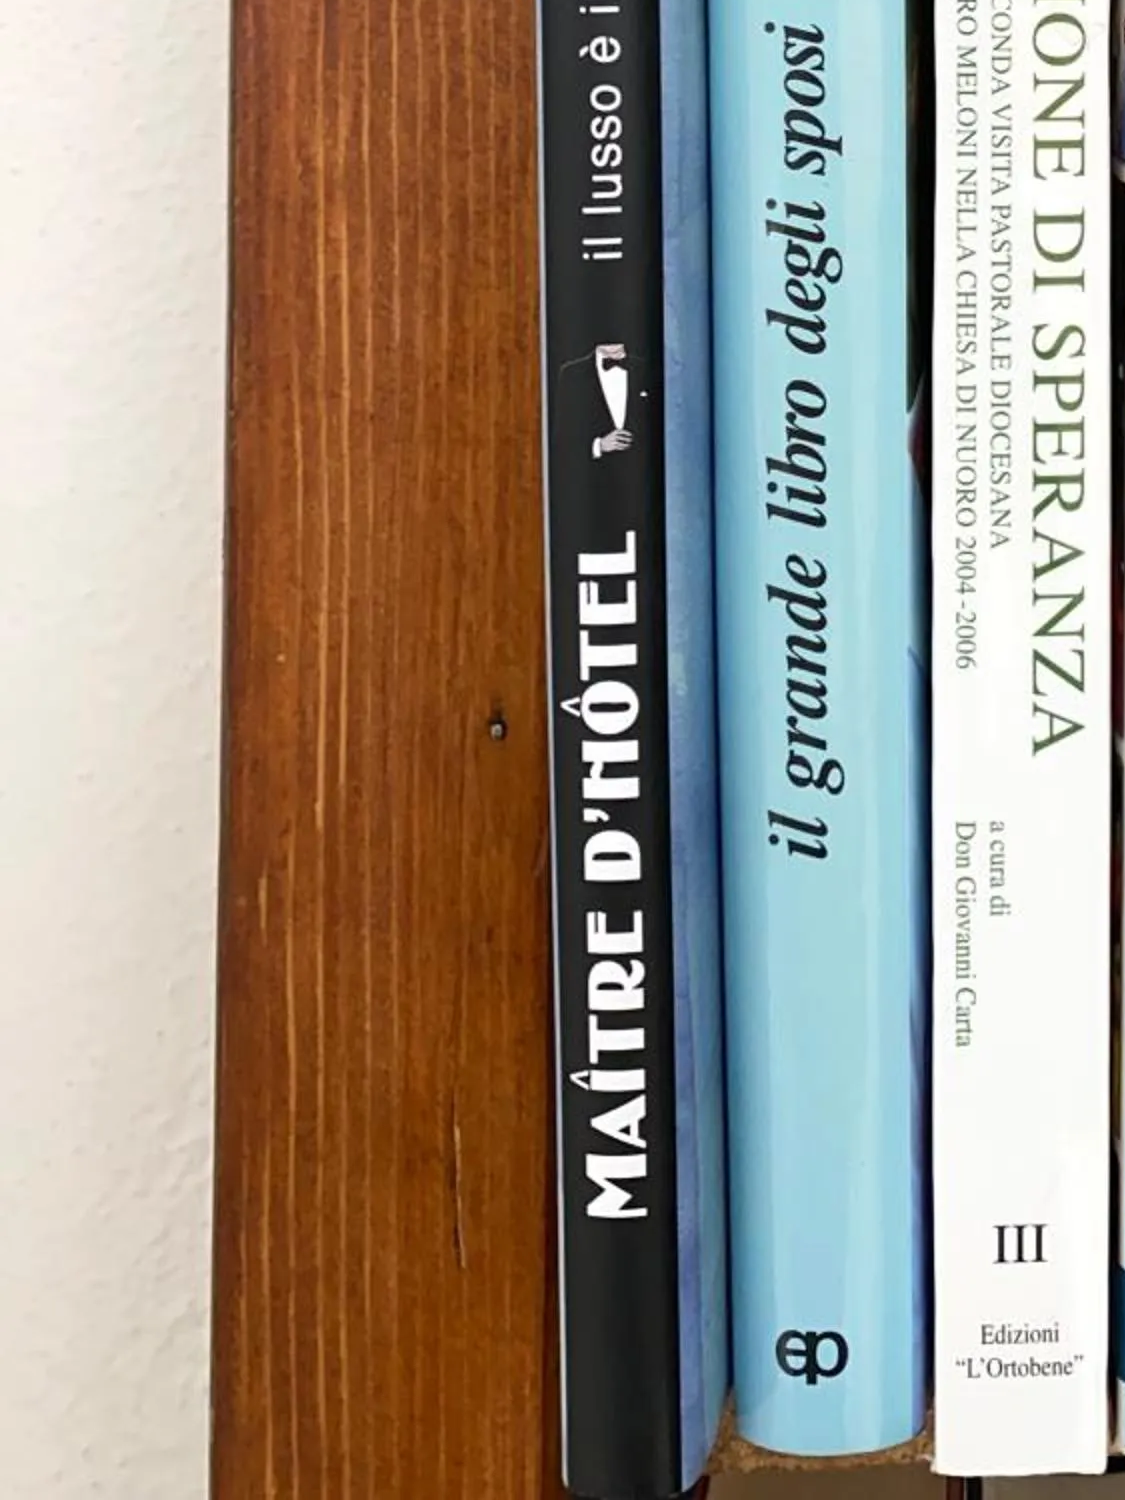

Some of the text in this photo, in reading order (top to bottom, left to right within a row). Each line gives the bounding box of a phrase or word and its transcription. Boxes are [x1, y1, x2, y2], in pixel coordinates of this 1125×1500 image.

[579, 36, 622, 63] è
[954, 45, 978, 158] MELONI
[583, 84, 623, 217] lusso
[989, 103, 1012, 195] VISITA
[582, 235, 623, 261] il
[954, 168, 978, 262] NELLA
[1031, 207, 1086, 292] DI
[954, 270, 978, 374] CHIESA
[989, 204, 1012, 370] PASTORALE
[764, 20, 845, 859] il grande libro degli sposi
[954, 384, 978, 415] DI
[954, 423, 978, 527] NUORO
[989, 380, 1012, 549] DIOCESANA
[1031, 322, 1087, 758] SPERANZA
[561, 531, 648, 1219] MAÎTRE D'HÔTEL
[988, 821, 1011, 917] a cura di
[953, 821, 977, 1047] Don Giovanni Carta
[992, 1223, 1048, 1264] III
[980, 1322, 1059, 1347] Edizioni
